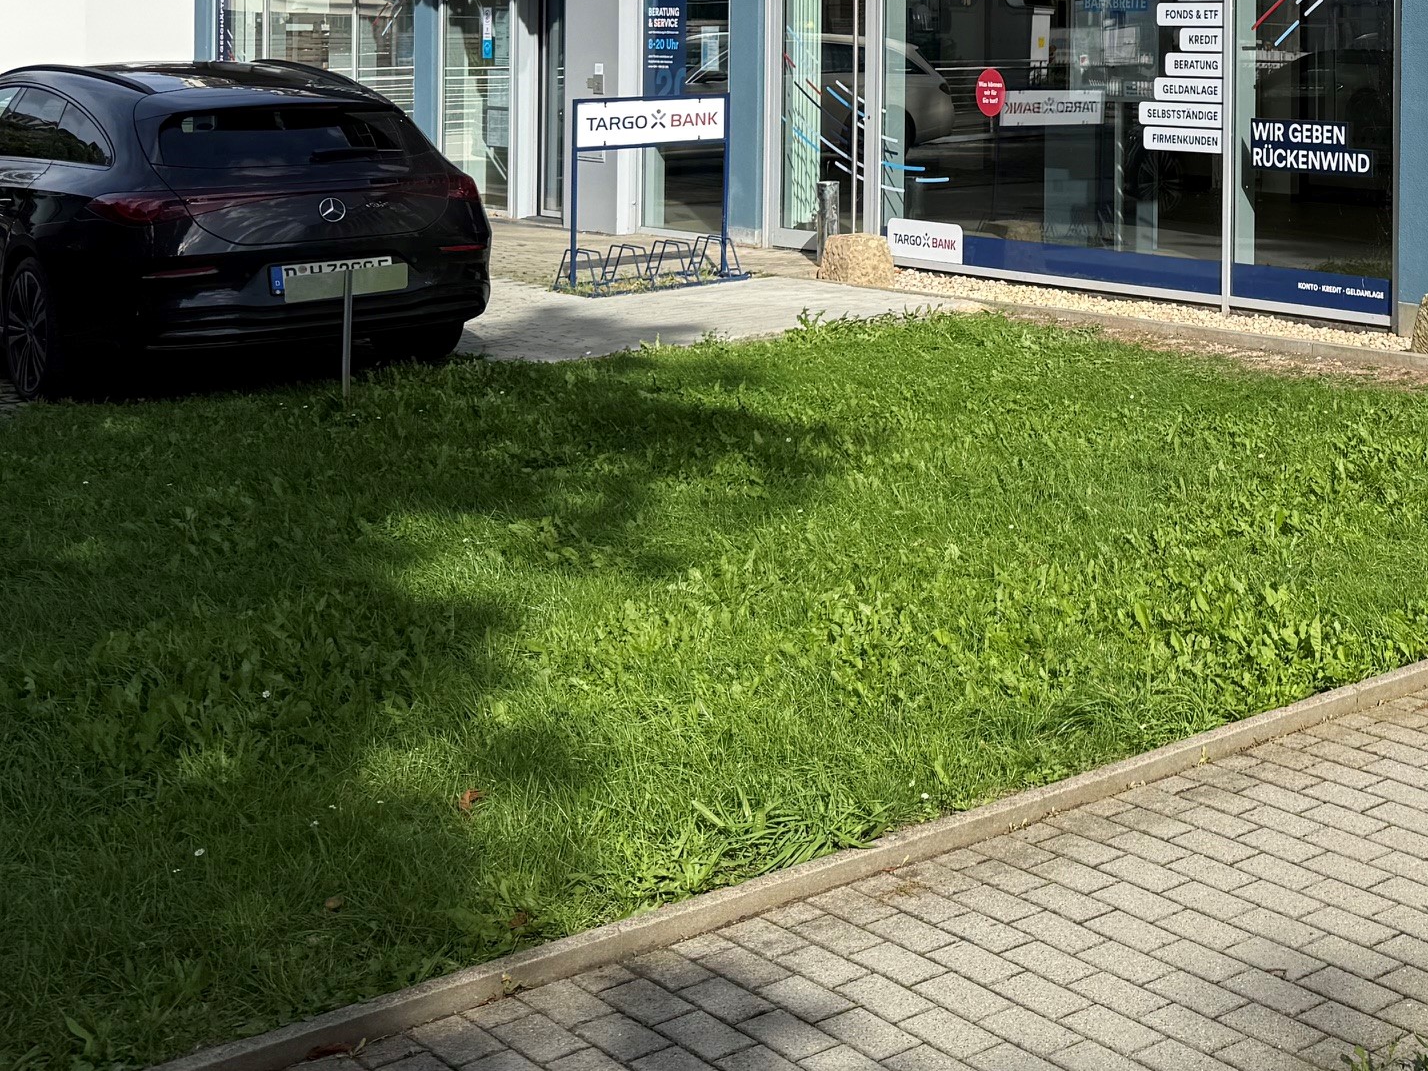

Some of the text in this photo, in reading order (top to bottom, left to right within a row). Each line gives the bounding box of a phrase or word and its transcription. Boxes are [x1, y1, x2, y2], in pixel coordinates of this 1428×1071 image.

[648, 7, 680, 17] BERATUNG
[1165, 9, 1219, 20] FONDS & ETF
[648, 18, 679, 28] & SERVICE
[666, 38, 679, 50] Uhr
[1188, 34, 1219, 45] KREDIT
[1173, 59, 1219, 70] BERATUNG
[1162, 84, 1219, 96] GELDANLAGE
[1147, 108, 1219, 121] SELBSTSTÄNDIGE
[586, 111, 719, 131] TARGO BANK
[1152, 133, 1219, 146] FIRMENKUNDEN
[1252, 122, 1346, 145] WIR GEBEN
[1252, 144, 1370, 173] RÜCKENWIND
[893, 232, 957, 251] TARGO BANK
[1297, 281, 1384, 300] KONTO KREDIT GELDANLAGE
